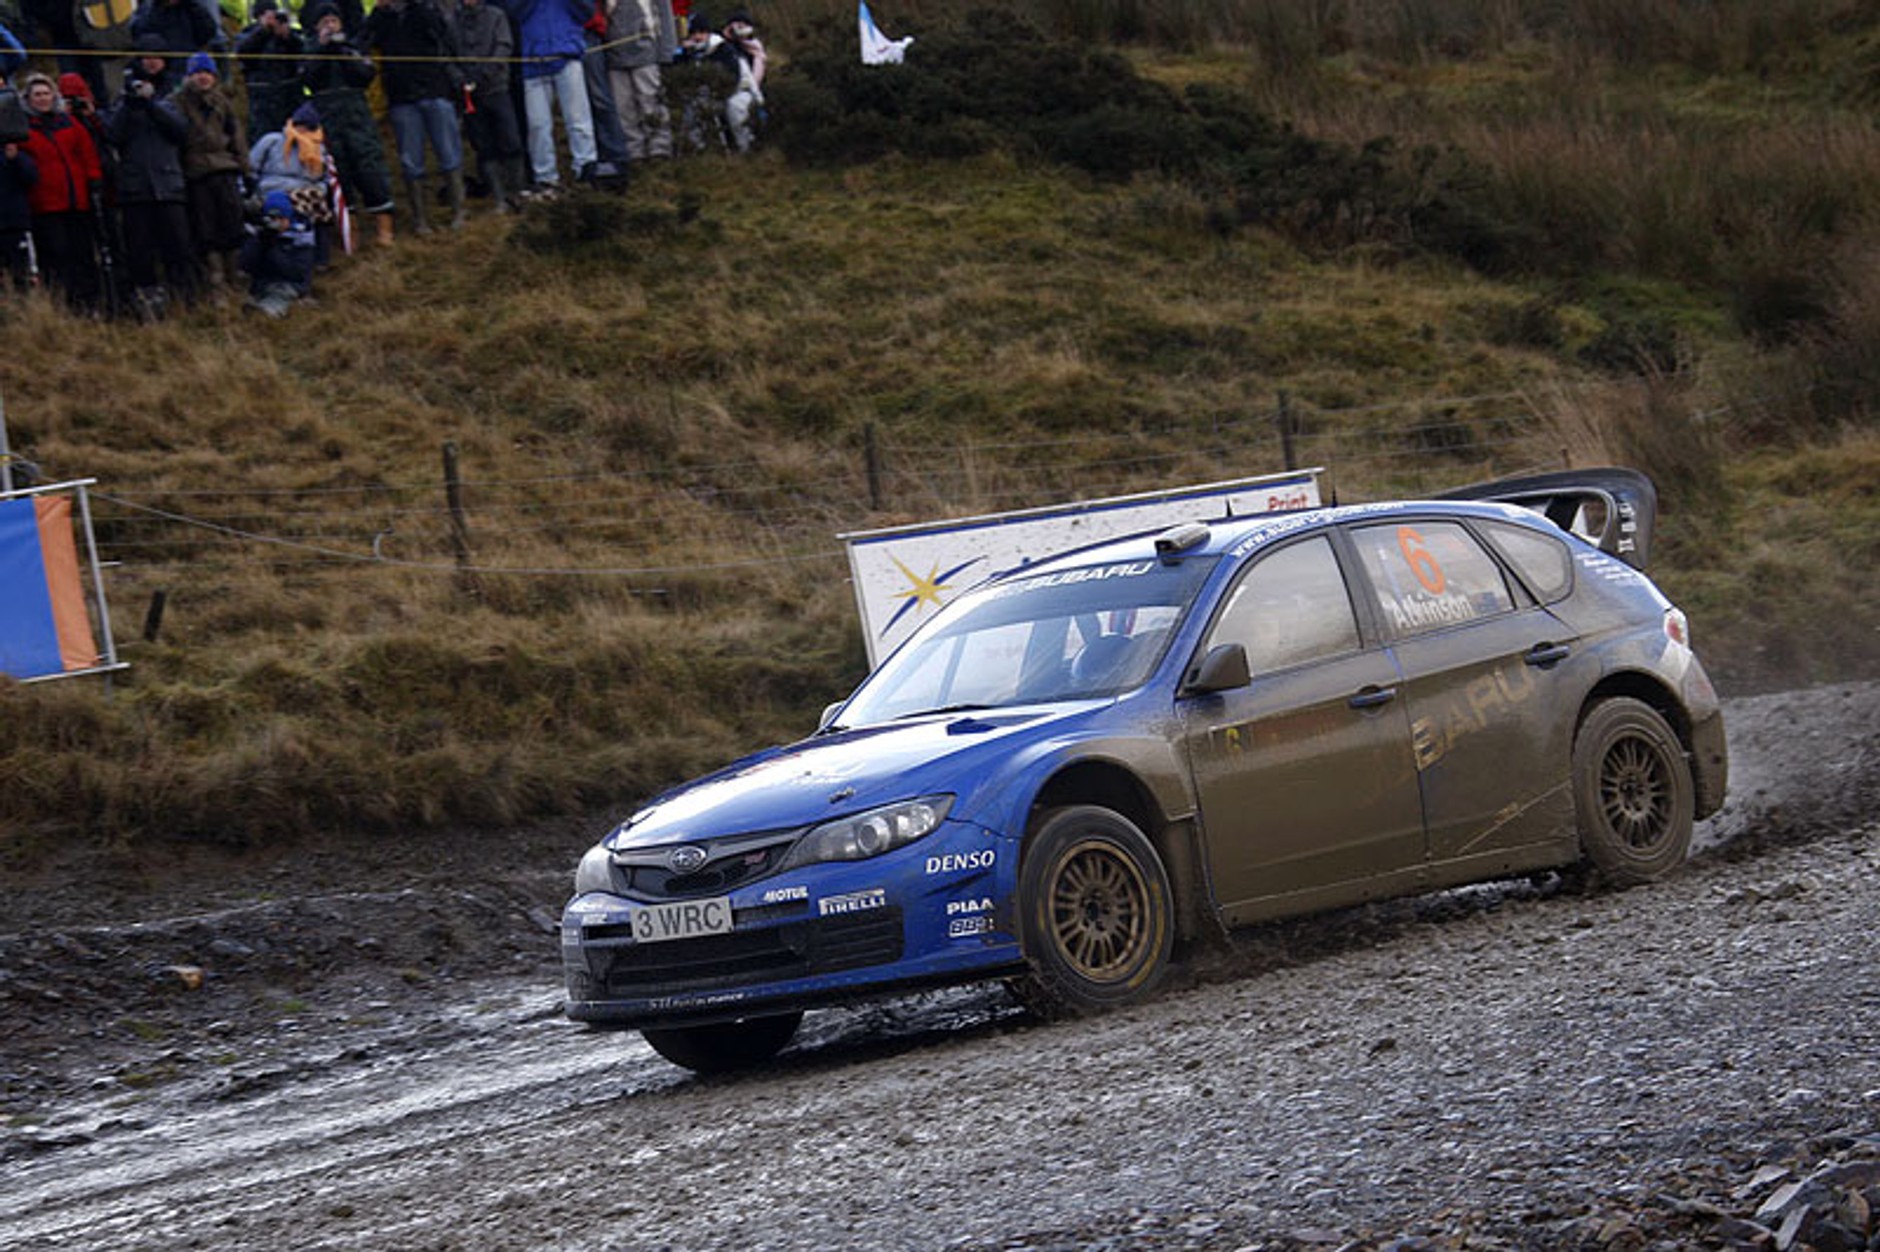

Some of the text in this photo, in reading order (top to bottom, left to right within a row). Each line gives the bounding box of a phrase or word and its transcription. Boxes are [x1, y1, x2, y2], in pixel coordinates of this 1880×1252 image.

[1029, 552, 1154, 591] SUBARU
[1396, 526, 1446, 596] 6
[1393, 592, 1472, 629] Atkinson
[925, 850, 996, 875] DENSO
[763, 885, 809, 903] MOTUL
[818, 888, 885, 916] PIRELLI
[946, 897, 995, 915] PIAA
[636, 902, 724, 939] 3 WRC
